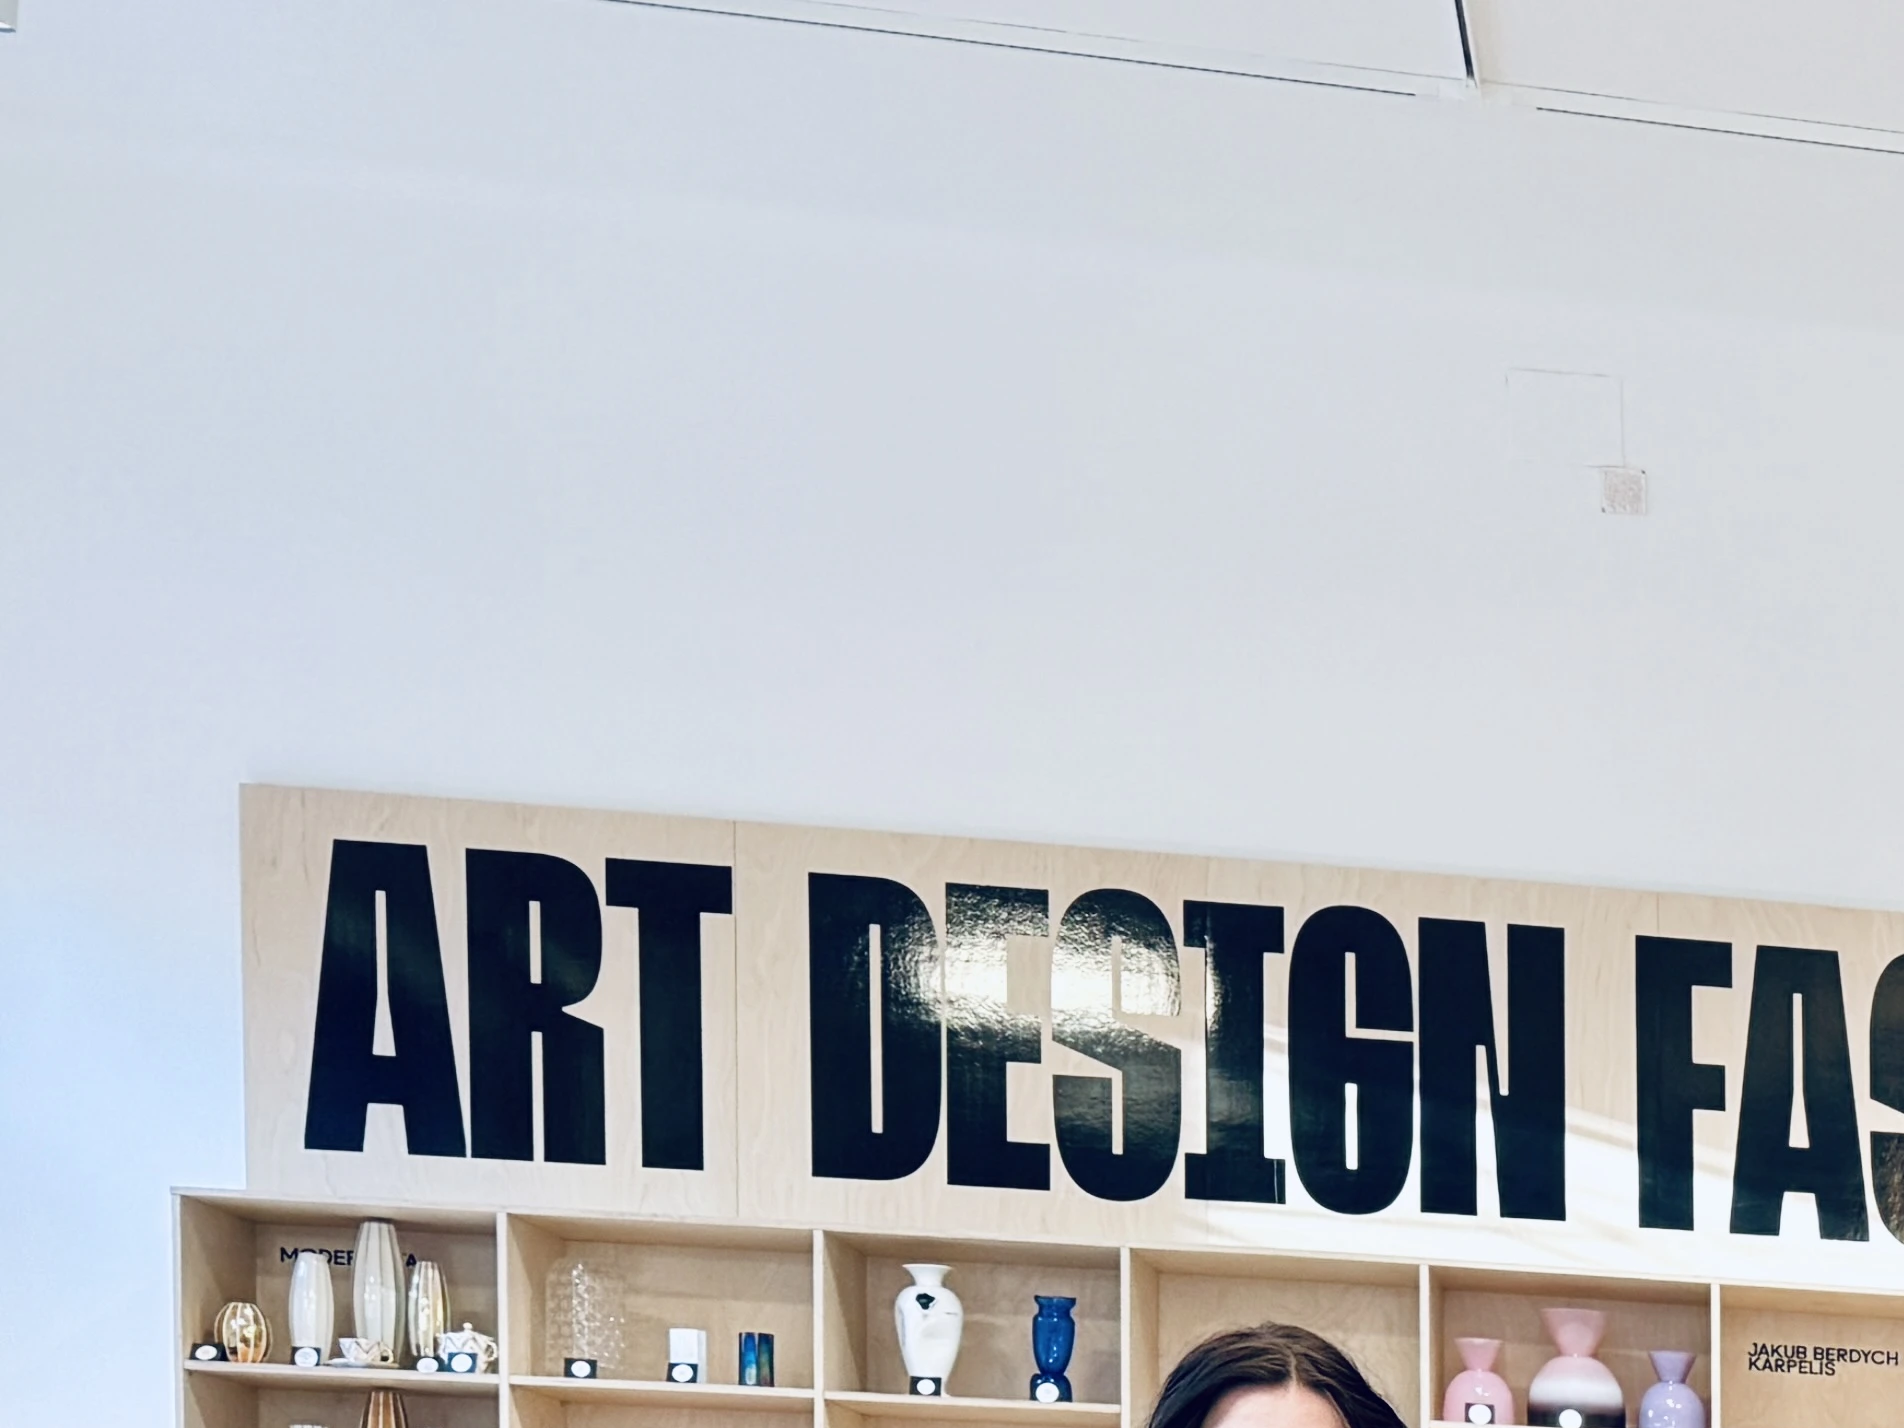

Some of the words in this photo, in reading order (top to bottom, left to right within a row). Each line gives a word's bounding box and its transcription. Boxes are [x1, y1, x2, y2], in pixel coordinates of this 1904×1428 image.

[305, 839, 733, 1170] ART
[808, 872, 1566, 1222] DESIGN
[1748, 1342, 1808, 1359] JAKUB
[1813, 1346, 1899, 1366] BERDYCH
[1748, 1357, 1836, 1376] KARPELIS
